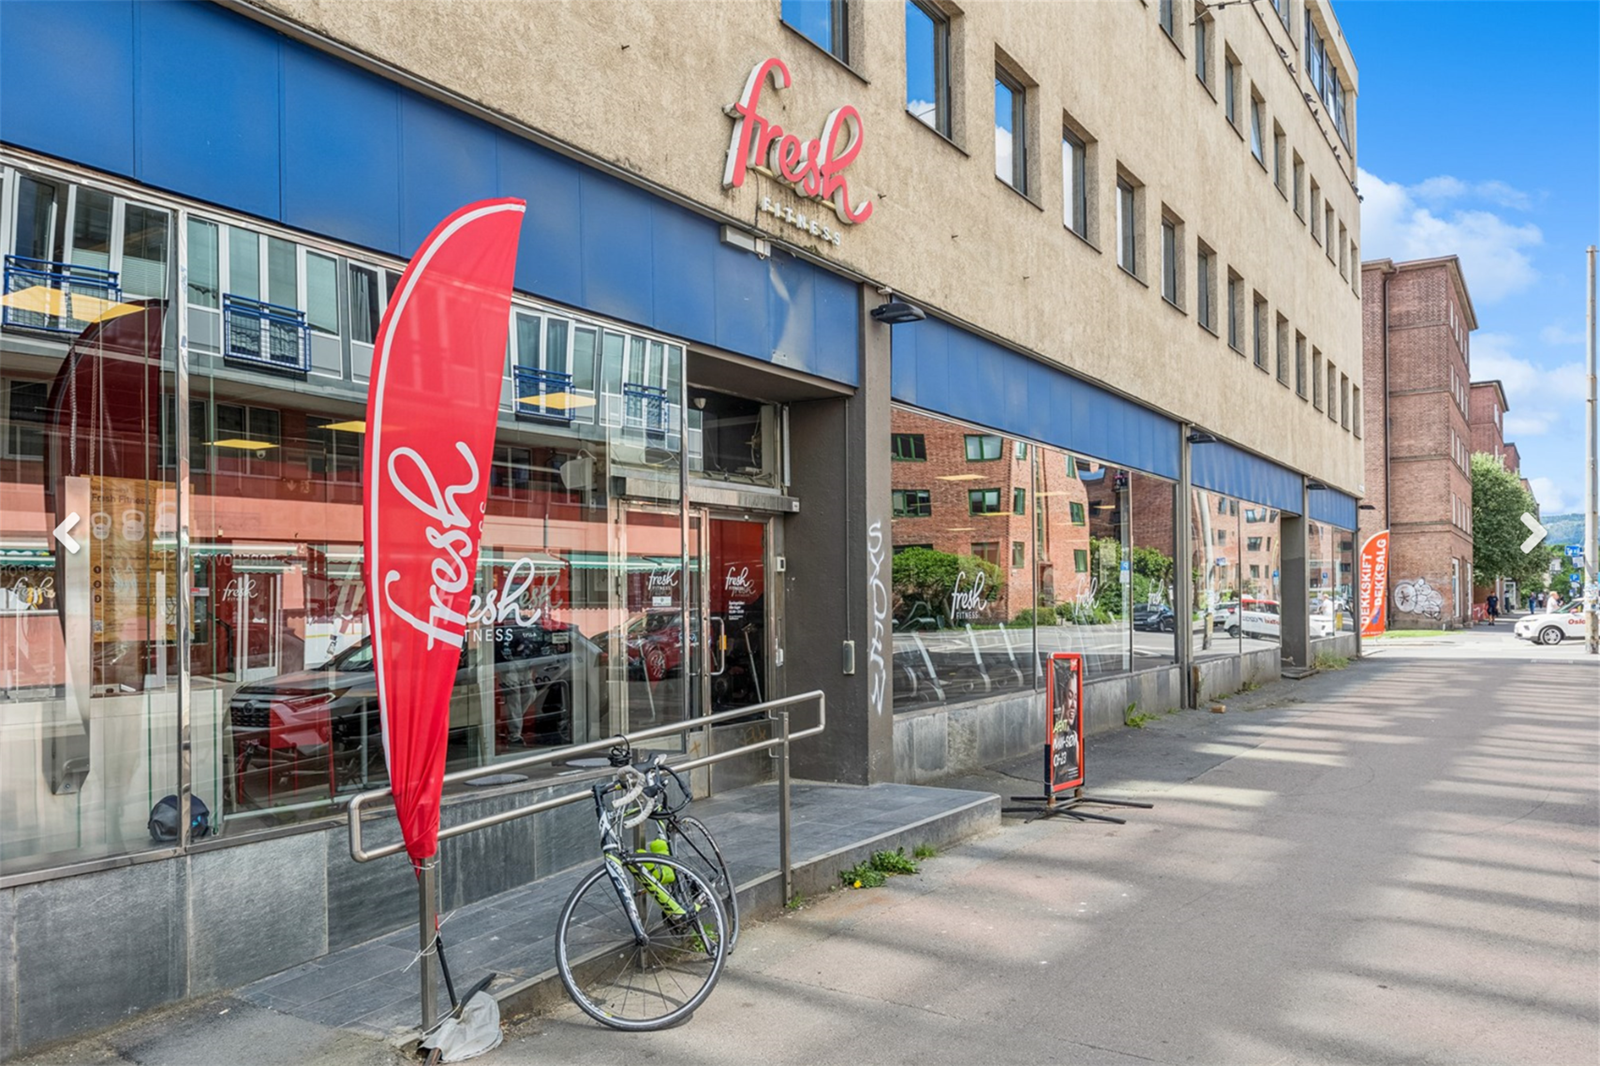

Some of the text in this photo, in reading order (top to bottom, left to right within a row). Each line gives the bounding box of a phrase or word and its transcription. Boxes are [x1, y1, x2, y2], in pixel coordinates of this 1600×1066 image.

[723, 57, 873, 225] fresh
[759, 197, 841, 246] FITNESS
[385, 441, 480, 651] fresh
[222, 579, 258, 602] fresh
[466, 557, 541, 627] esh
[648, 564, 678, 590] fresh
[725, 566, 750, 590] fresh
[951, 570, 988, 620] fresh
[1360, 553, 1373, 625] DEKKSKIFT
[1374, 539, 1387, 606] DEKKSALG
[464, 628, 514, 642] TNESS
[956, 611, 979, 620] FITNESS
